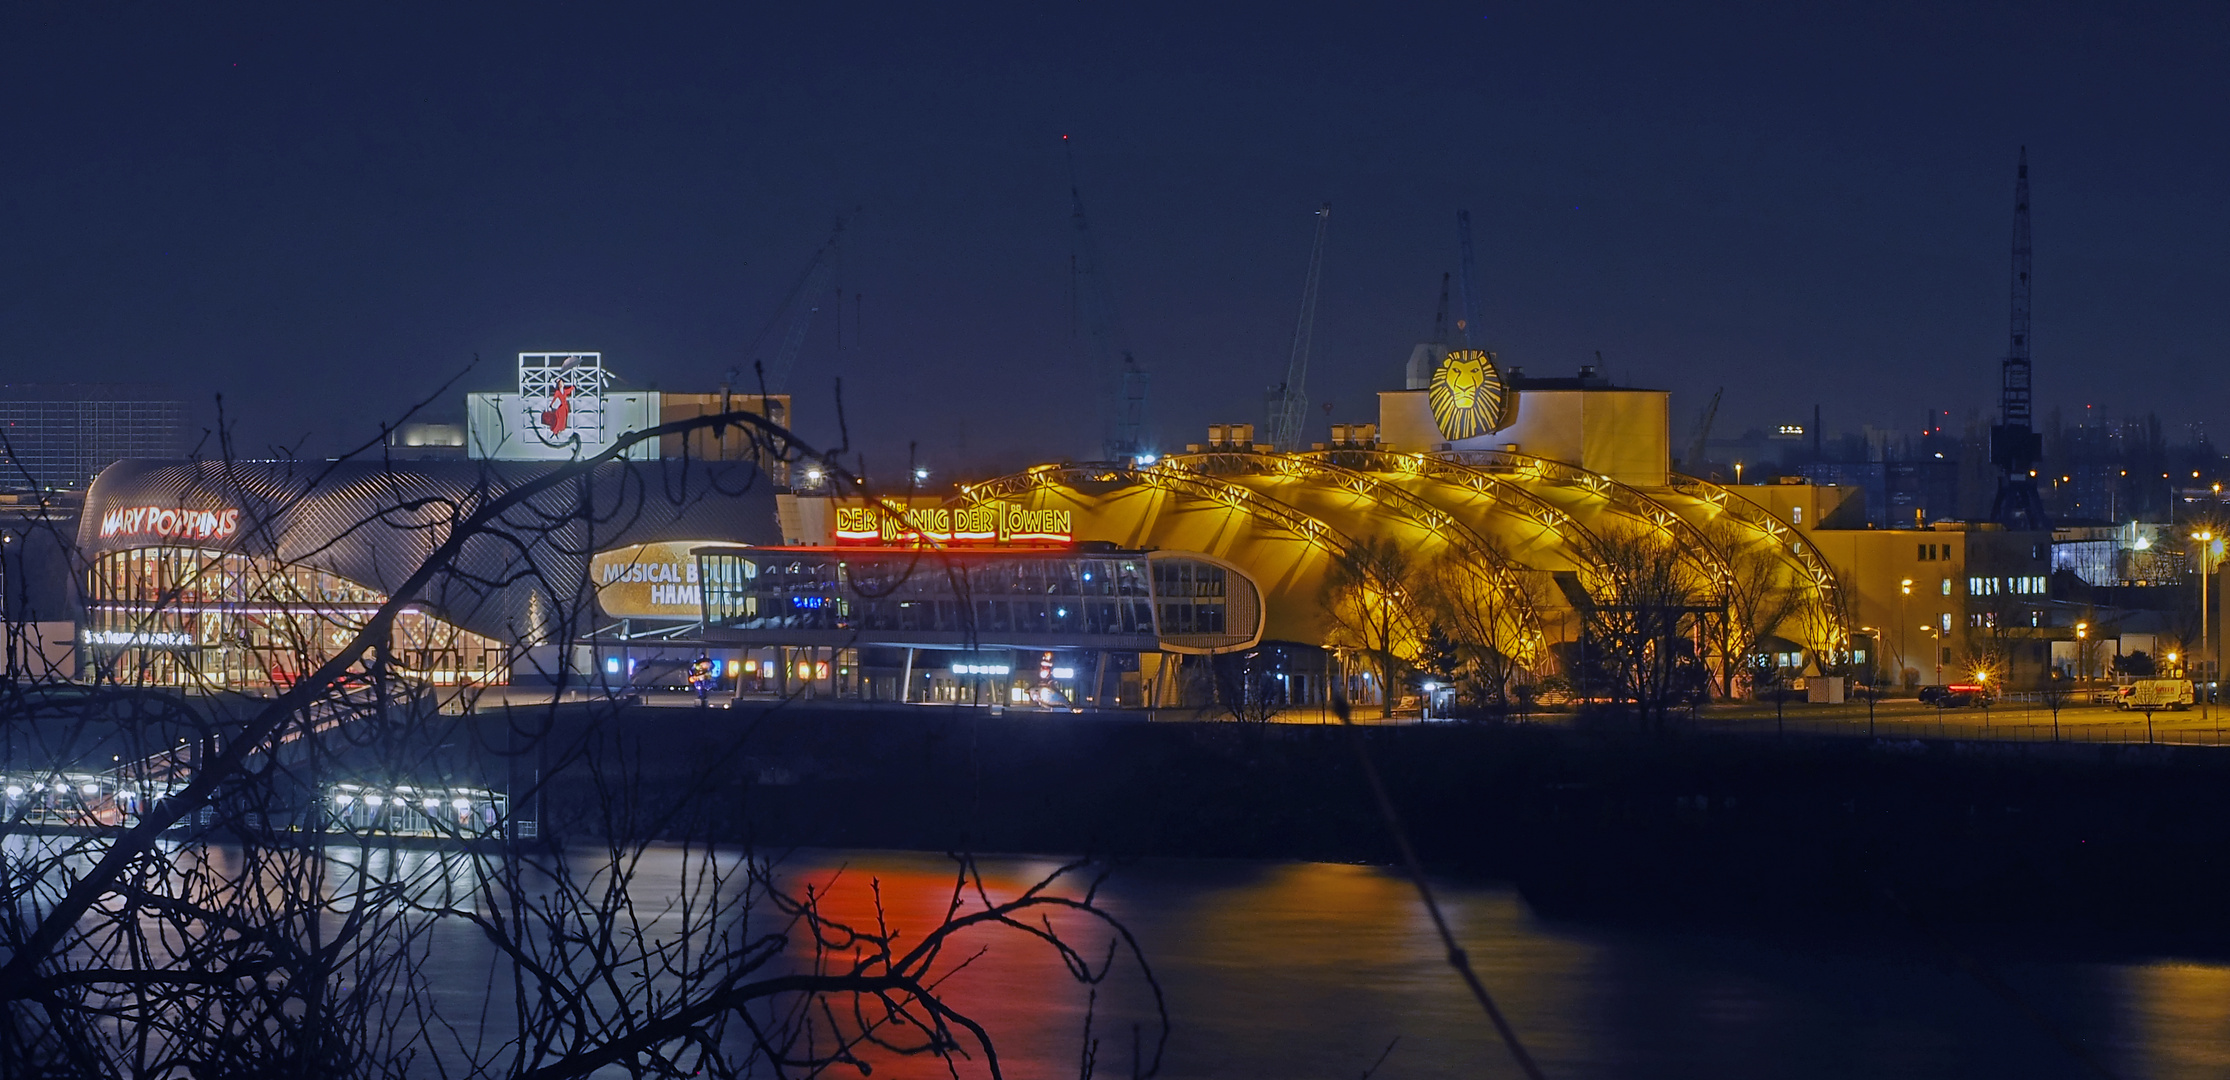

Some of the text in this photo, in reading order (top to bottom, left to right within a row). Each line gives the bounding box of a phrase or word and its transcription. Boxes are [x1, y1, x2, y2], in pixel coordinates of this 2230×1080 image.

[99, 506, 239, 540] MARY POPPINS
[837, 508, 877, 532] DER
[954, 508, 994, 533] DER
[1000, 501, 1071, 541] LÖWEN
[602, 563, 682, 584] MUSICAL
